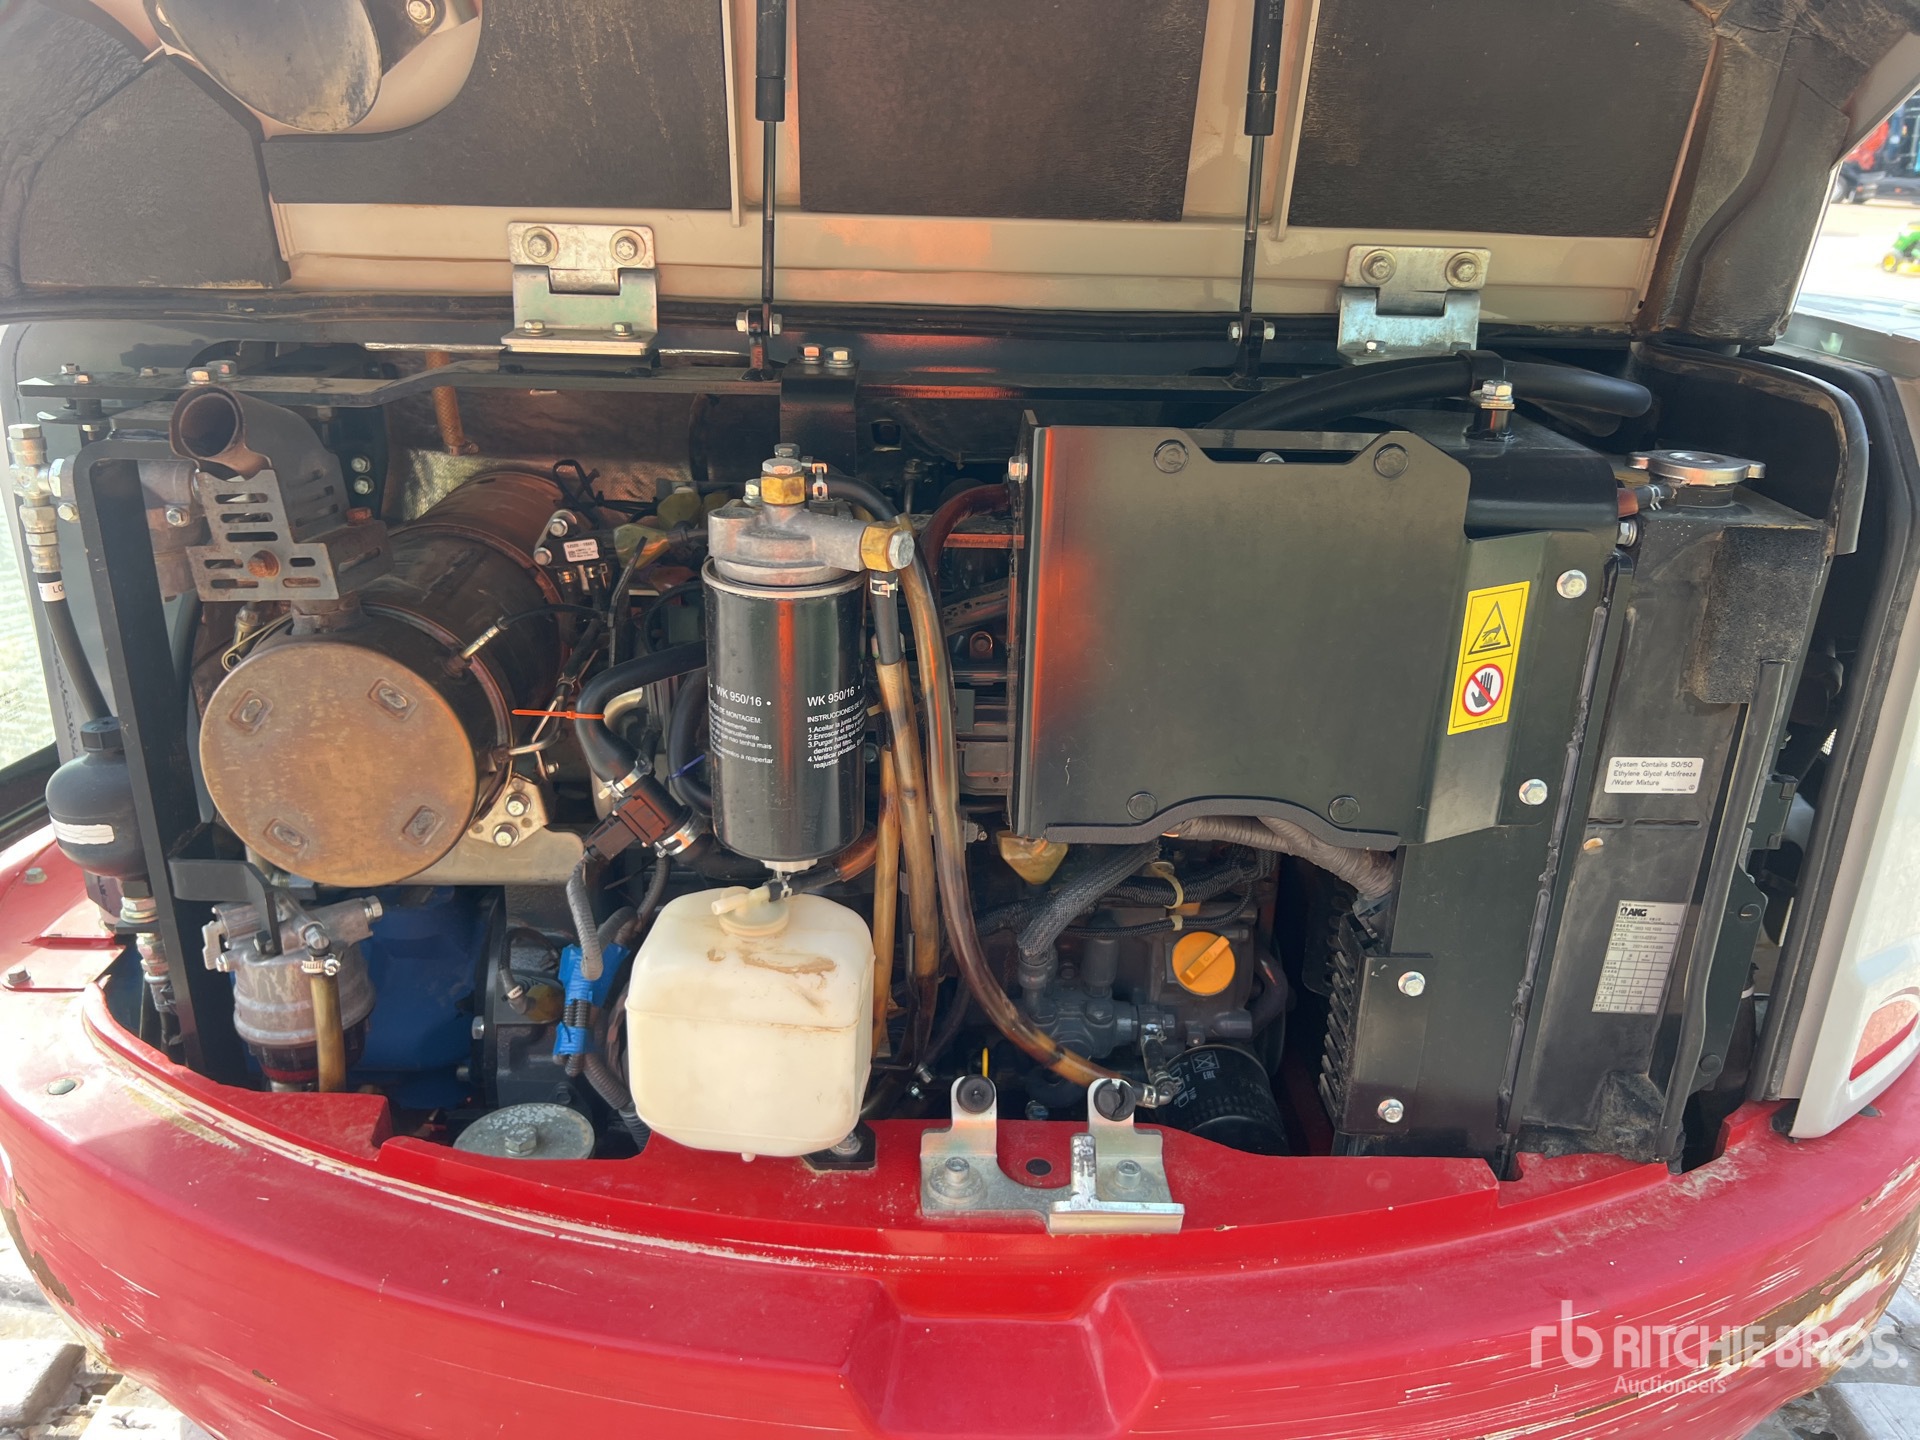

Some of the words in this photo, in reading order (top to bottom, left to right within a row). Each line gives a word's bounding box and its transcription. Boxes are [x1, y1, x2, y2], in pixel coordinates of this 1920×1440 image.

[716, 685, 728, 699] WK
[729, 691, 762, 707] 950/16
[807, 694, 826, 707] WK
[828, 686, 855, 704] 950/16
[725, 710, 763, 724] MONTAGEM:
[807, 707, 854, 723] INSTRUCCIONES
[739, 739, 756, 748] tenha
[756, 742, 773, 750] mais
[807, 739, 834, 749] 3.Purgar
[813, 746, 833, 755] dentro
[745, 755, 774, 764] reapertar
[807, 752, 838, 763] 4.Verificar
[1614, 761, 1638, 769] System
[1613, 770, 1640, 778] Ethylene
[1643, 770, 1662, 778] Glycol
[1627, 908, 1647, 917] AKG
